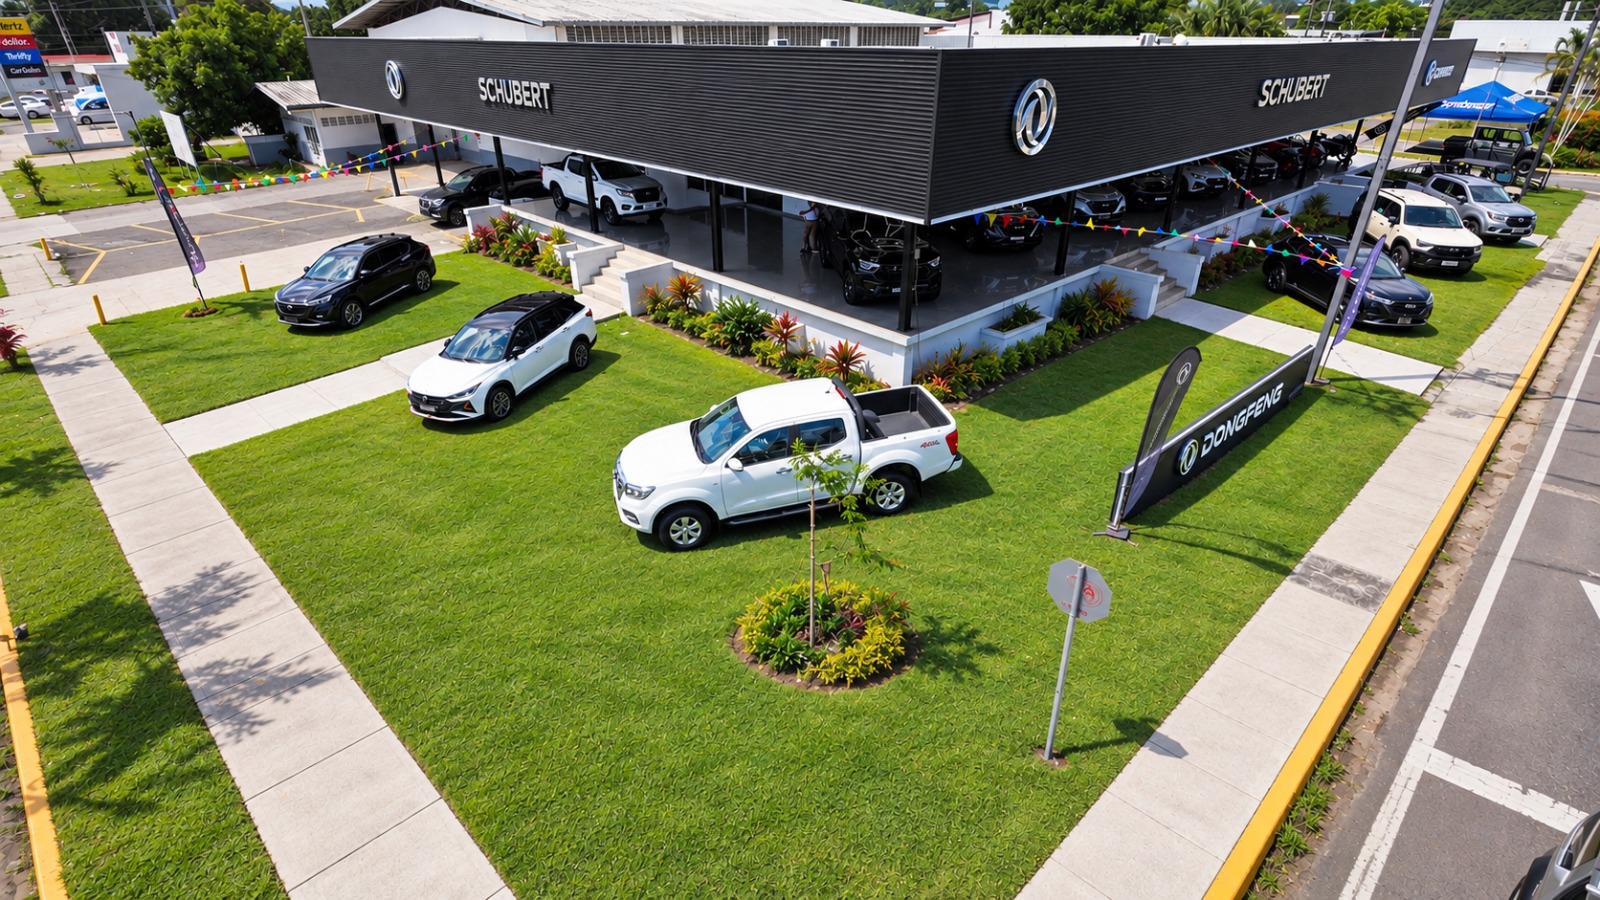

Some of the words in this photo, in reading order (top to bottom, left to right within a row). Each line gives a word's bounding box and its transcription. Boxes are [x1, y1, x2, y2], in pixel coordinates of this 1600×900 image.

[478, 77, 551, 110] SCHUBERT
[1257, 73, 1331, 108] SCHUBERT
[1200, 382, 1285, 459] DONGFENG
